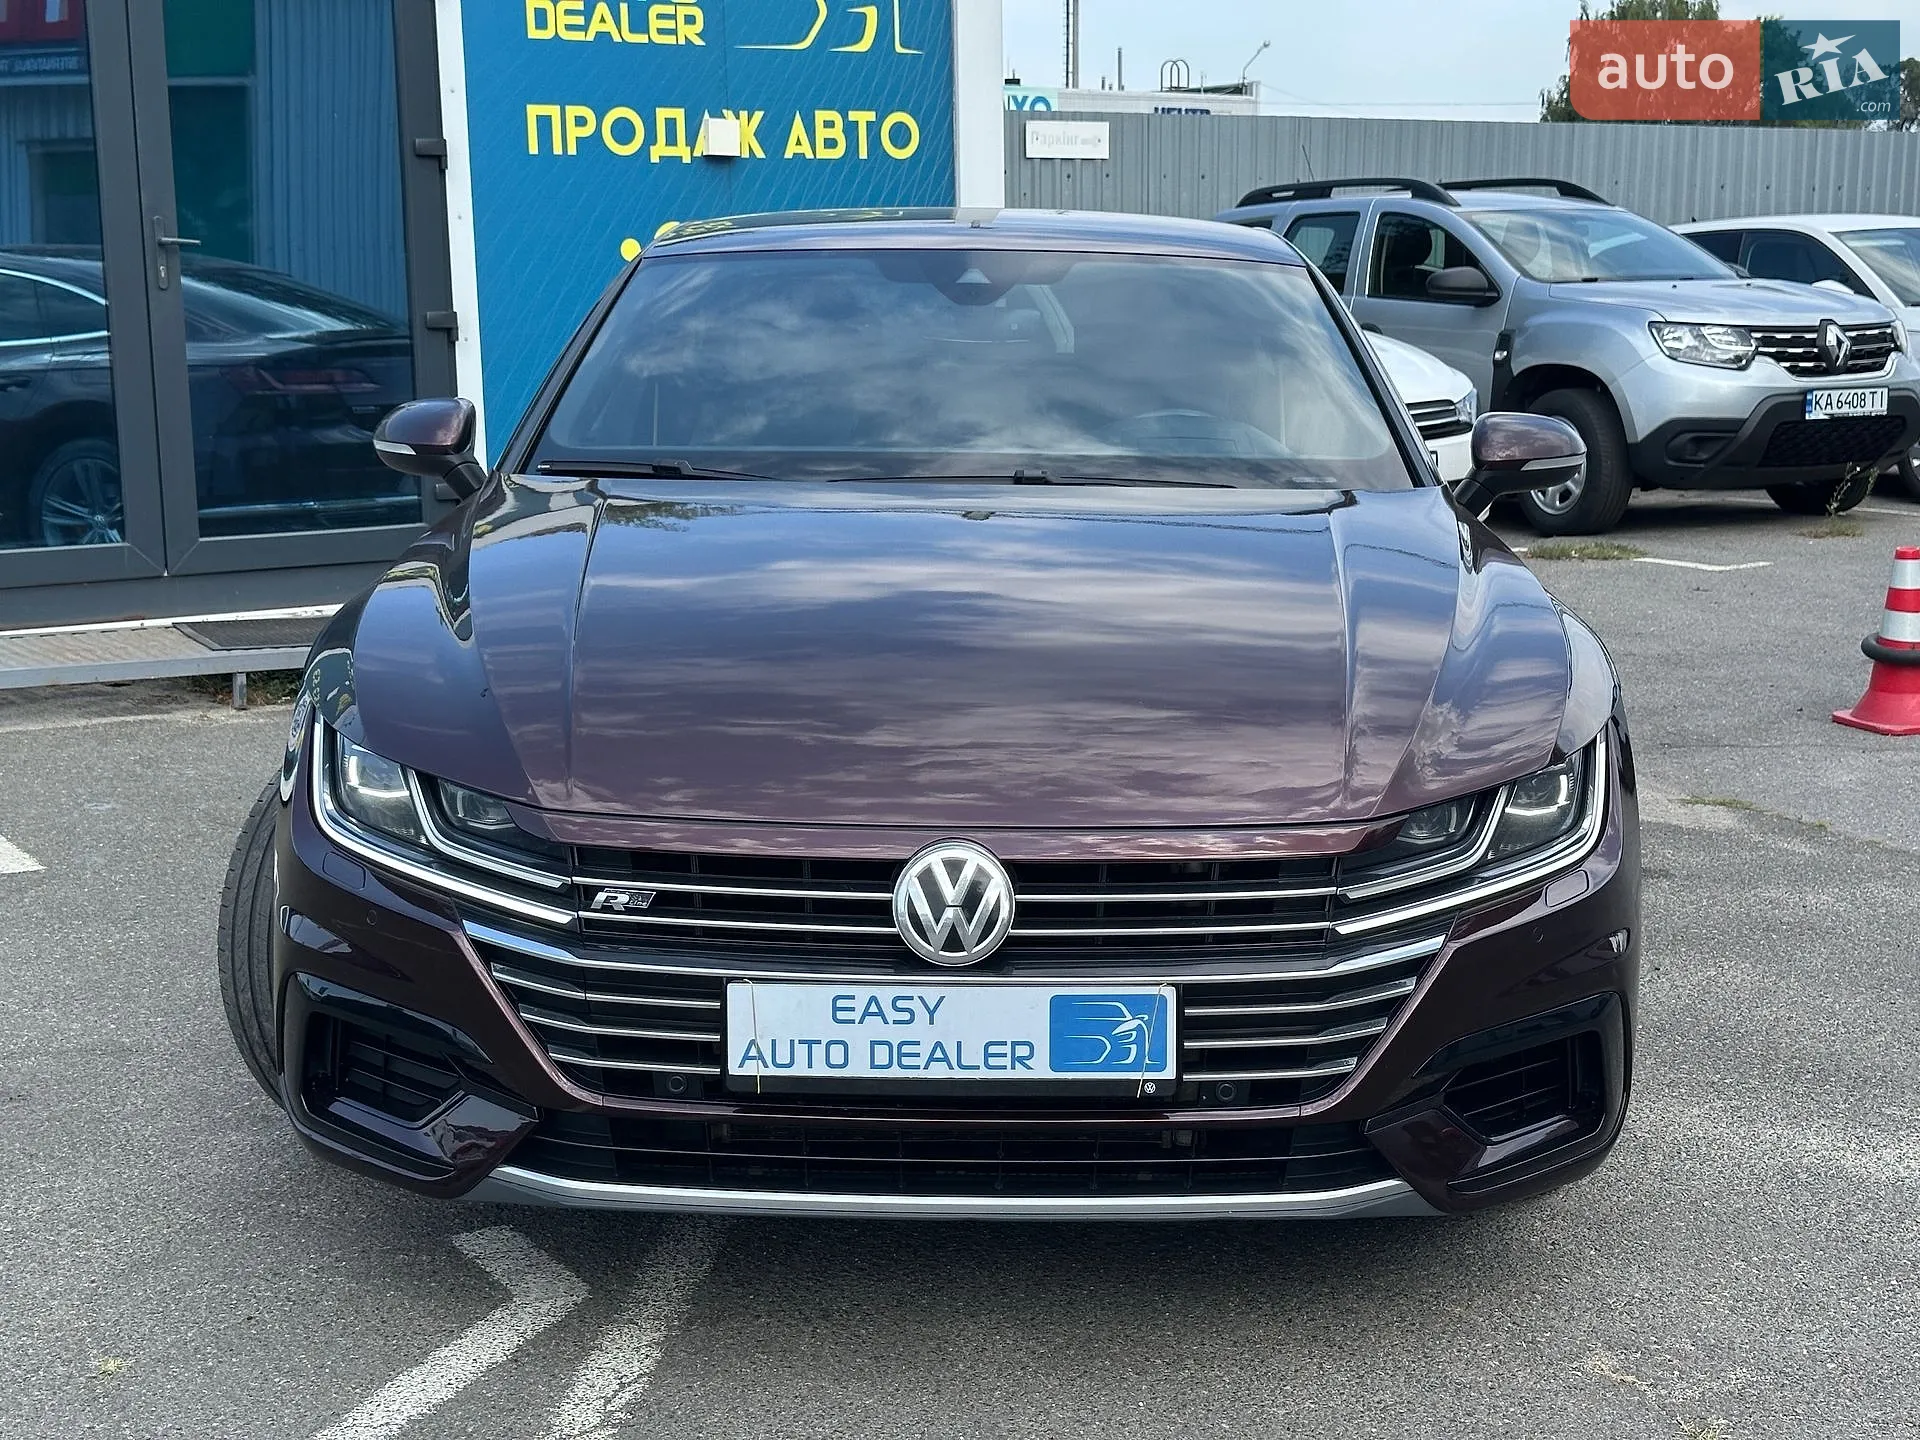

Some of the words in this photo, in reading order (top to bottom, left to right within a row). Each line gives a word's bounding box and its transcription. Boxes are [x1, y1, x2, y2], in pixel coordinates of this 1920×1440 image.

[526, 0, 706, 46] DEALER
[784, 110, 920, 160] АВТО
[1814, 393, 1833, 411] KA
[1836, 391, 1867, 409] 6408
[1869, 391, 1884, 408] TI
[831, 994, 946, 1025] EASY
[738, 1039, 849, 1069] AUTO
[868, 1040, 1036, 1071] DEALER
